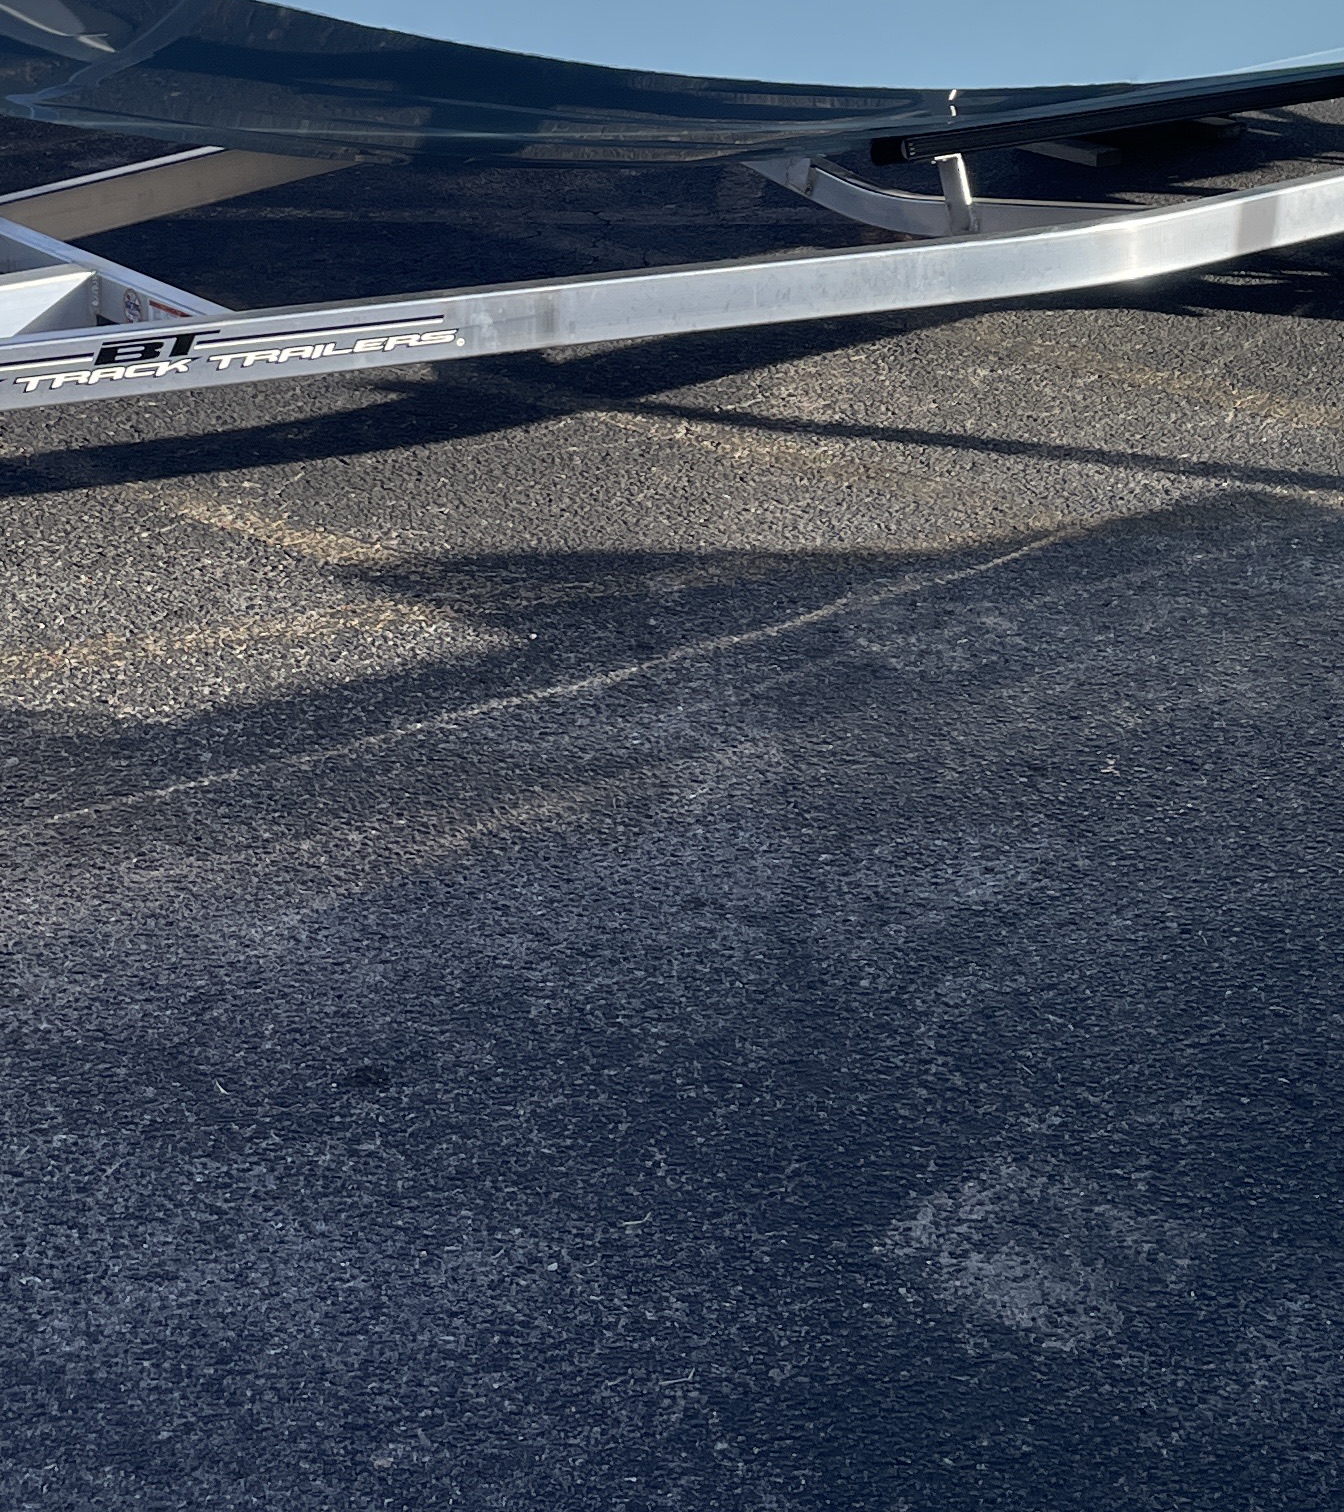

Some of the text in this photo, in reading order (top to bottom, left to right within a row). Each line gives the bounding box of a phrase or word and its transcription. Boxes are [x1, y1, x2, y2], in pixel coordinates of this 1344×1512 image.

[14, 356, 201, 393] TRACK
[209, 328, 459, 370] TRAILERS
[93, 329, 221, 367] BT
